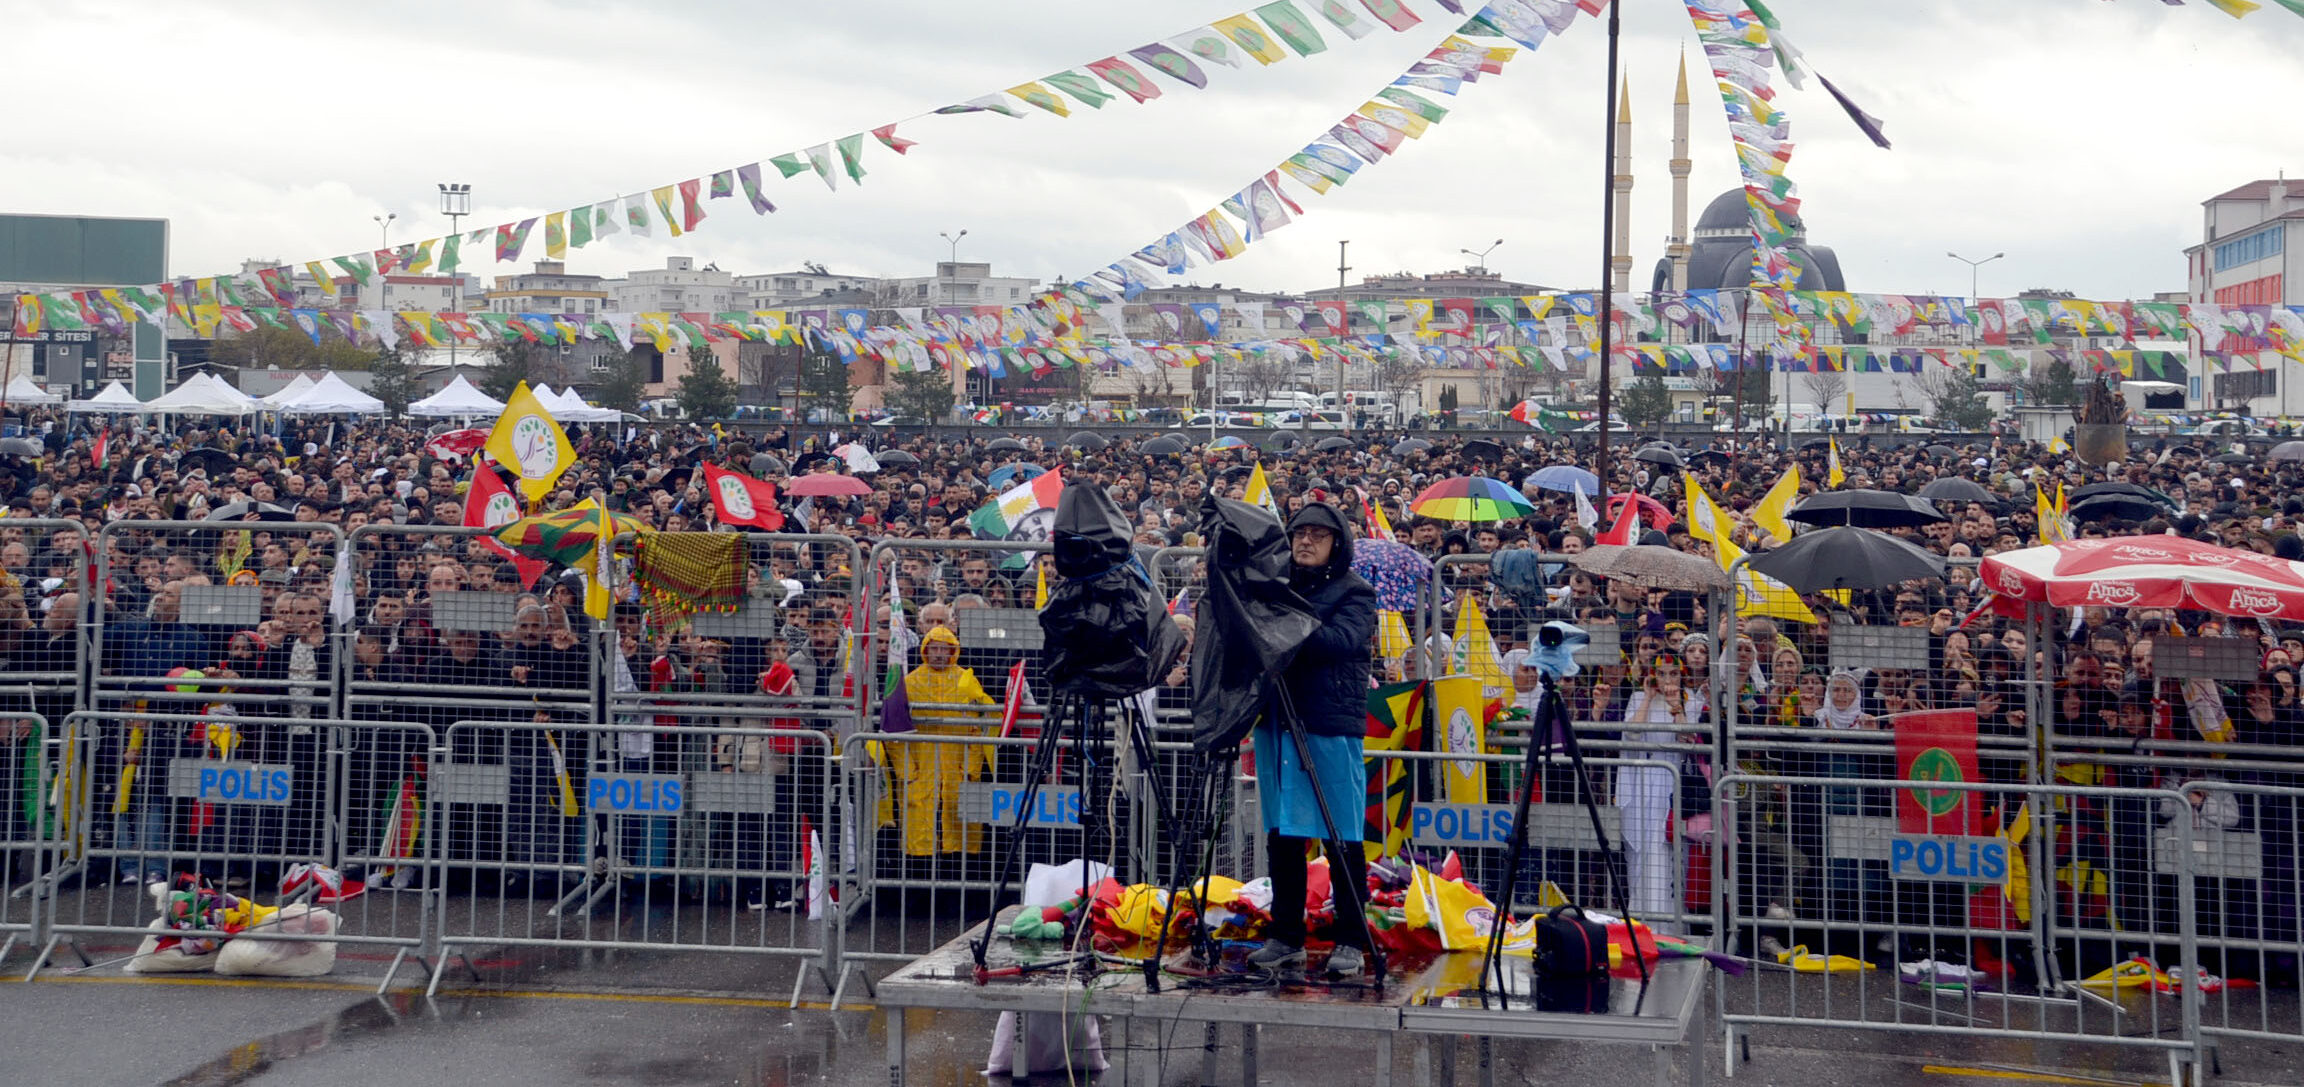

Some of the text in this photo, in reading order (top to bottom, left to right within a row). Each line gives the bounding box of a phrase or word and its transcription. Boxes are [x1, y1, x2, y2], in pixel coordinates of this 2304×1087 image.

[55, 329, 92, 342] SİTESİ
[2086, 581, 2135, 600] Amca
[2228, 588, 2278, 609] Amca
[200, 767, 289, 800] POLiS
[589, 778, 681, 811] POLiS
[992, 790, 1081, 823] POLiS
[1413, 807, 1513, 842] POLiS
[1892, 840, 2004, 878] POLiS
